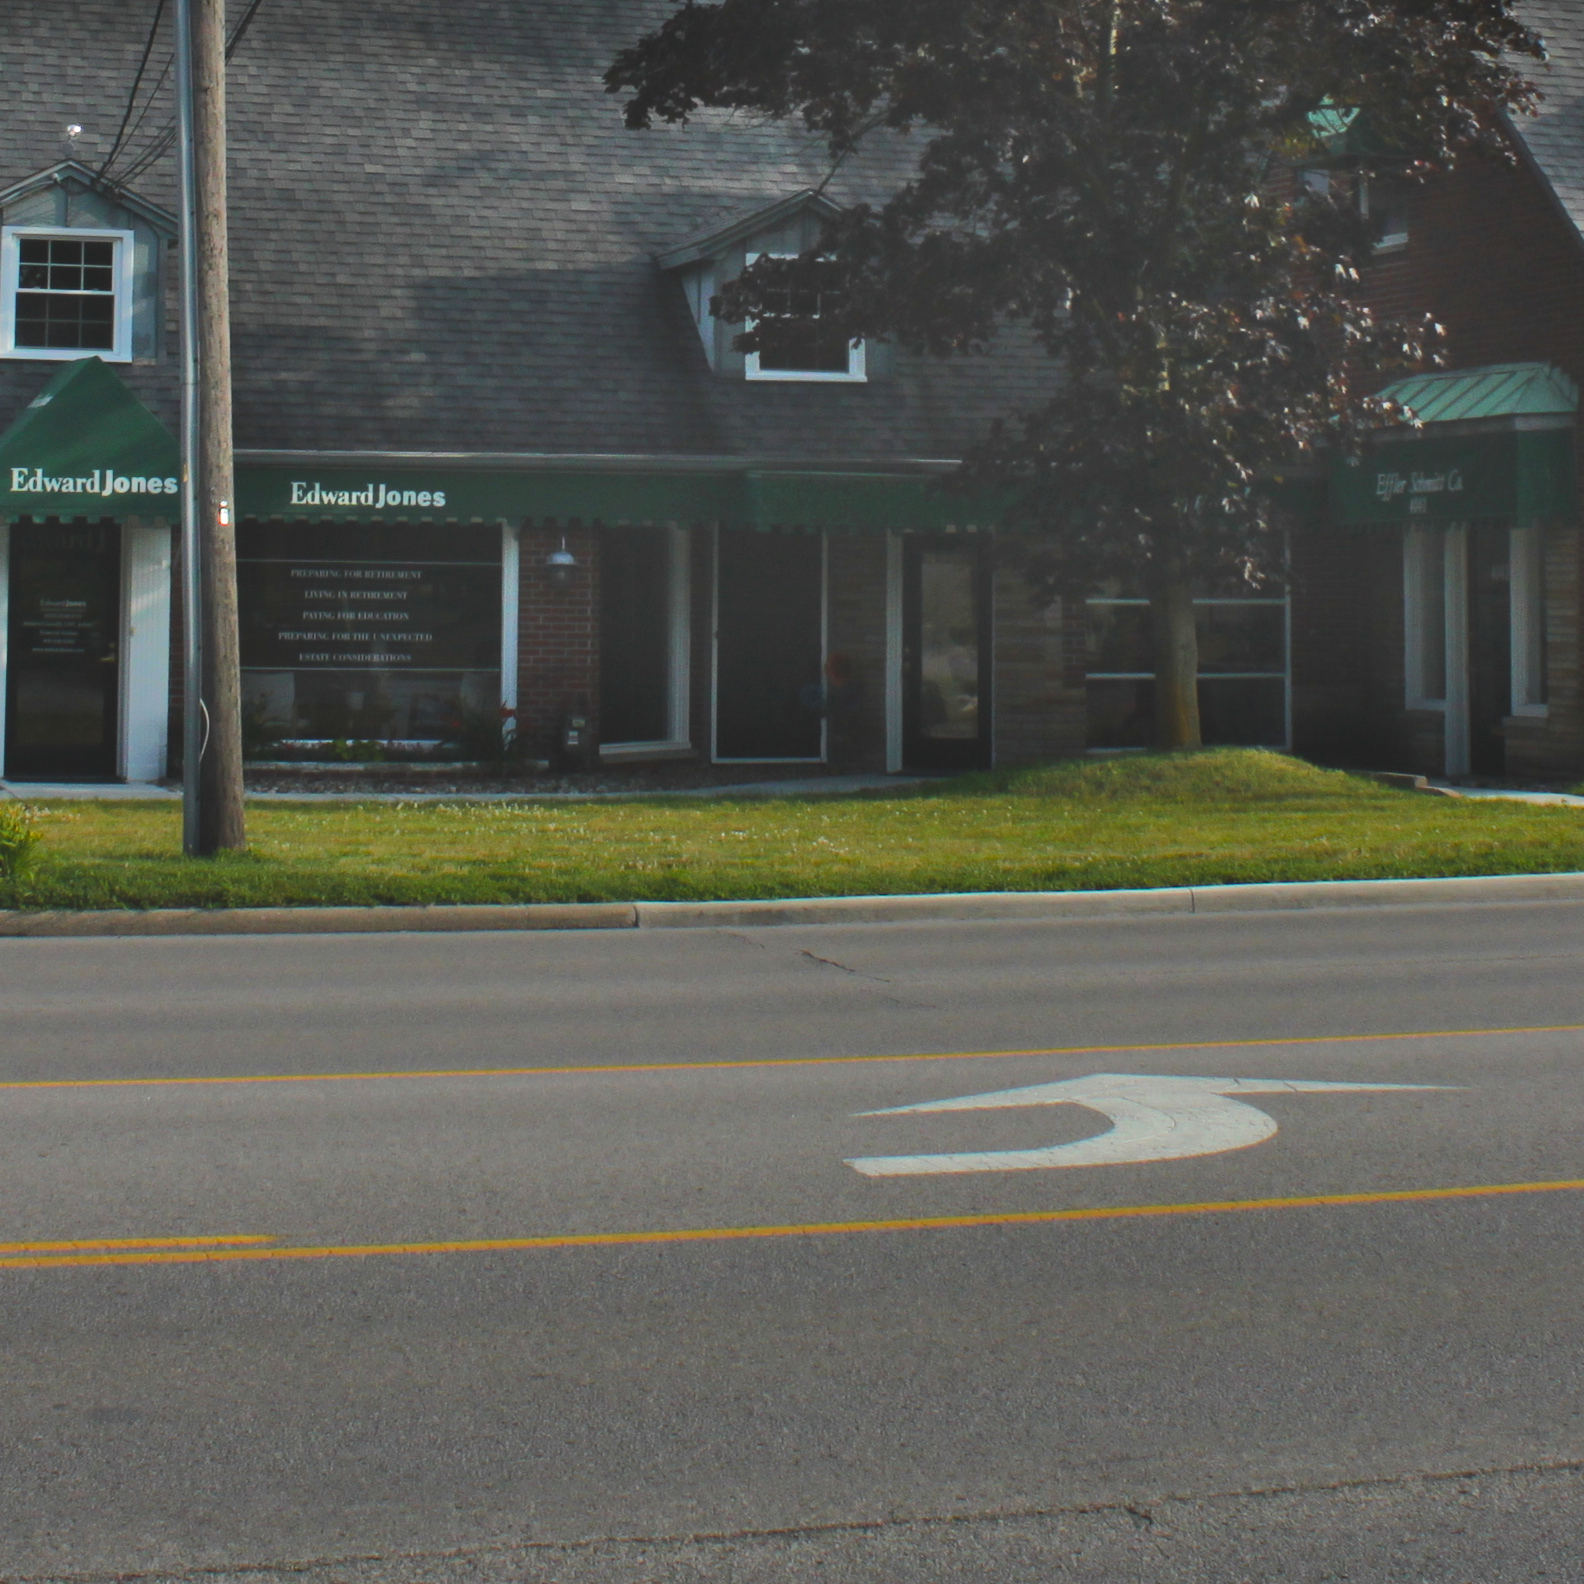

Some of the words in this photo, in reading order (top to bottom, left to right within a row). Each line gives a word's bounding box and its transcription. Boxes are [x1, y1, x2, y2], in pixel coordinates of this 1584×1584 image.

[291, 569, 342, 578] PREPARING
[344, 569, 362, 579] FOR
[364, 570, 422, 579] RETIREMENT
[304, 590, 335, 599] LIVING
[338, 590, 348, 599] IN
[350, 591, 408, 600] RETIREMENT
[303, 611, 335, 619] PAYING
[337, 611, 356, 620] FOR
[358, 612, 409, 620] EDUCATION
[278, 632, 329, 640] PREPARING
[332, 632, 351, 641] FOR
[353, 632, 370, 641] THE
[373, 632, 433, 641] UNEXPECTED
[299, 653, 330, 661] ESTATE
[332, 653, 412, 662] CONSIDERATIONS
